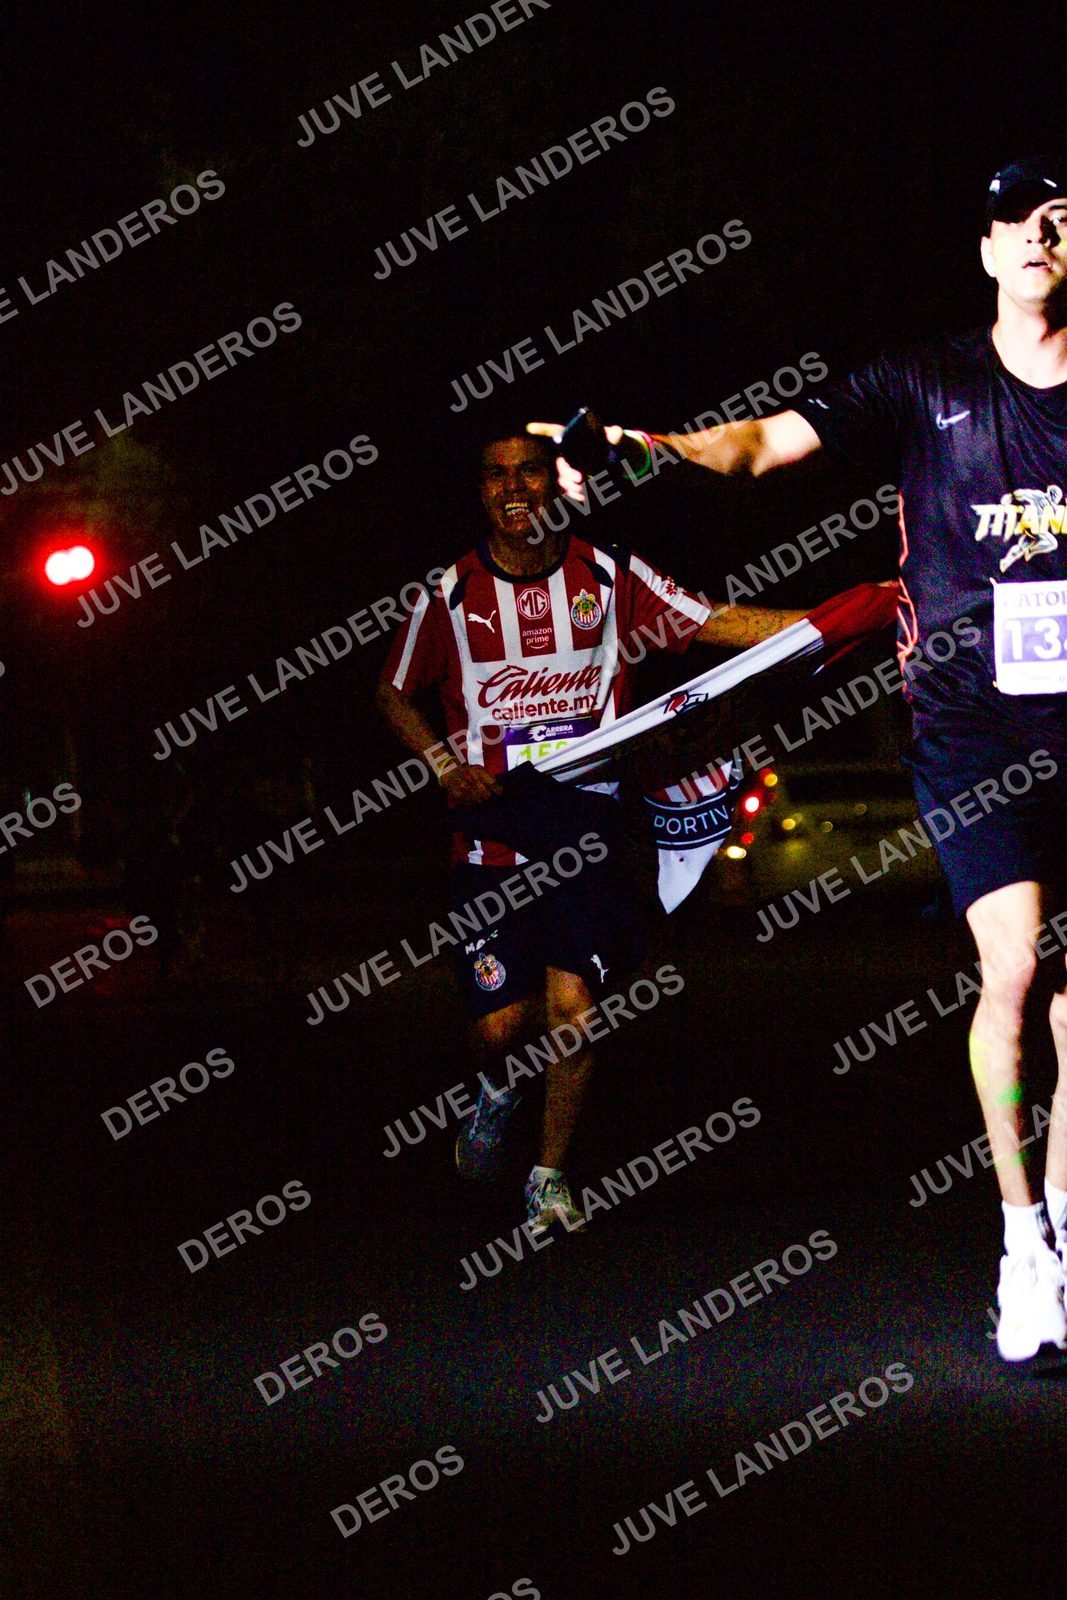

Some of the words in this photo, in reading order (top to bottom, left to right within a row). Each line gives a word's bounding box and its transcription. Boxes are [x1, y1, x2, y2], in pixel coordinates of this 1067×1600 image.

[970, 502, 1067, 542] TITAN
[519, 592, 547, 617] MG
[522, 627, 552, 637] amazon
[526, 635, 549, 645] prime
[1005, 618, 1067, 661] 13
[477, 665, 602, 708] Caliente
